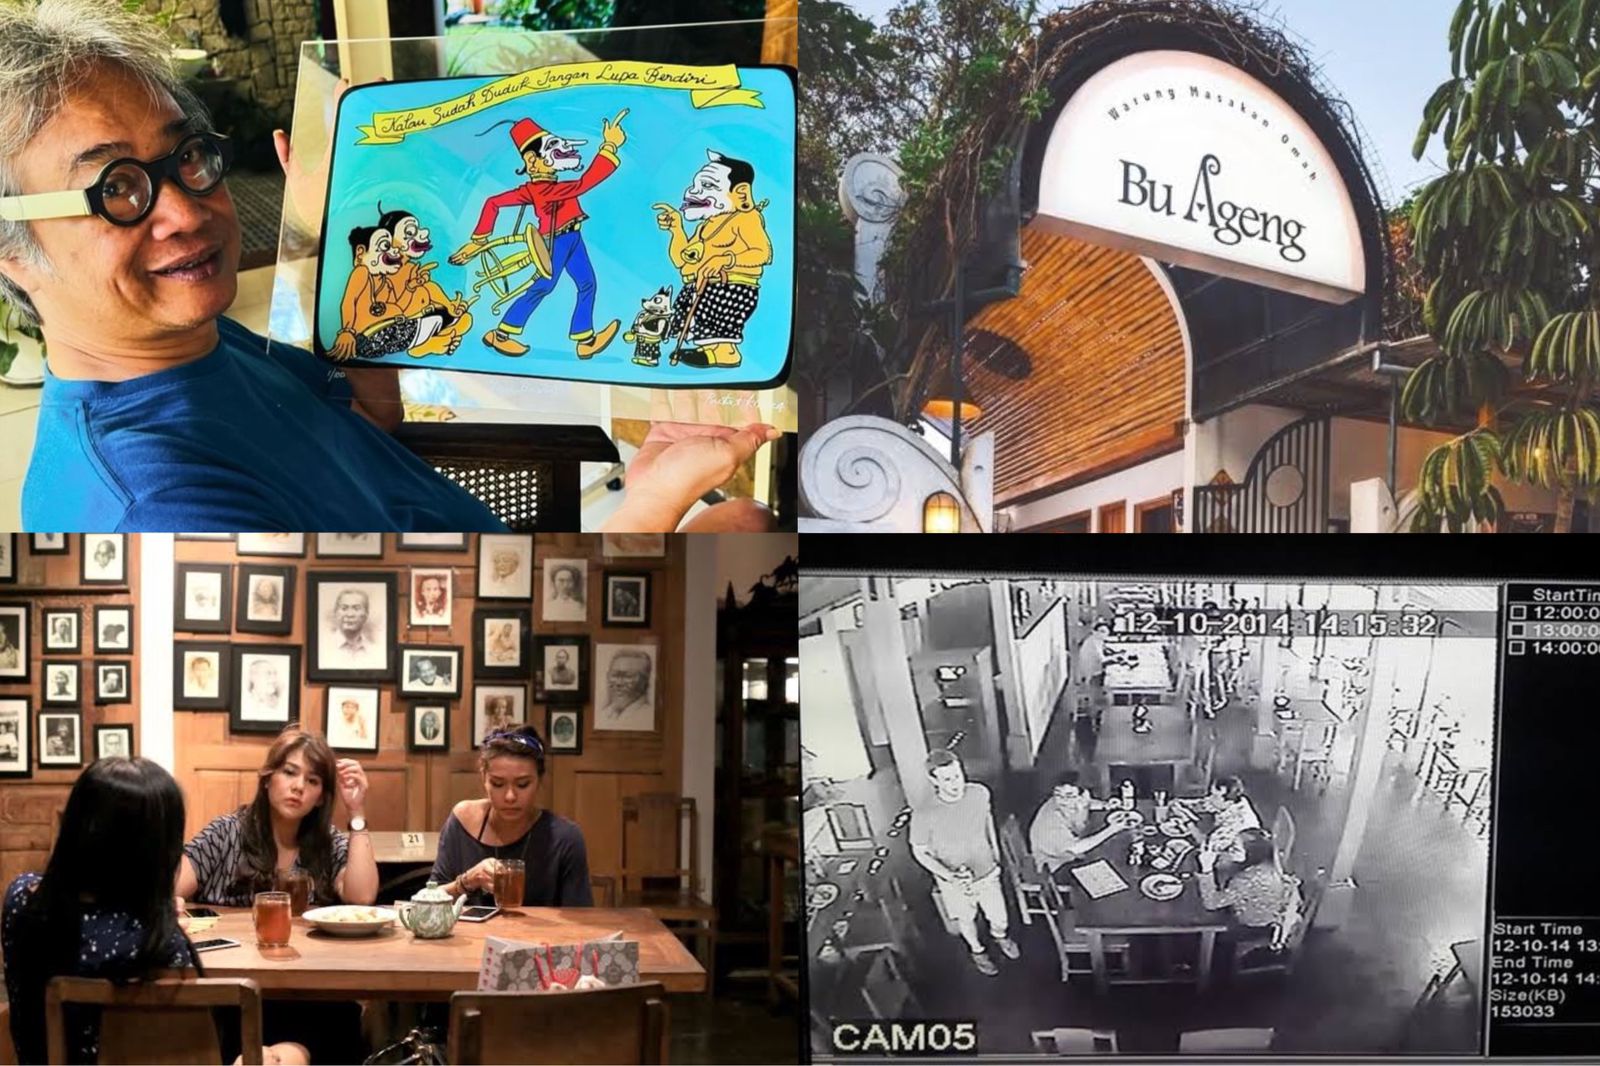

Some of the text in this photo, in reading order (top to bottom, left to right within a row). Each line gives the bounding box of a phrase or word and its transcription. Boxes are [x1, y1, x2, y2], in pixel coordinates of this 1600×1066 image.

[382, 63, 717, 133] Kalau Sudah Duduk Jangan Lupa Berdiri
[1107, 86, 1318, 181] Warung Masakan Omah
[1117, 153, 1307, 263] Bu Ageng
[1124, 611, 1437, 636] 12-10-2014 14:15:32
[1532, 641, 1600, 655] 14:00:0
[407, 834, 420, 843] 21
[1493, 922, 1583, 936] Start Time
[1494, 939, 1571, 952] 12-10-14
[1491, 956, 1574, 969] End Time
[1492, 972, 1569, 985] 12-10-14
[1490, 988, 1566, 1005] Size(KB)
[1491, 1005, 1555, 1018] 153033
[832, 1023, 976, 1051] CAM05
